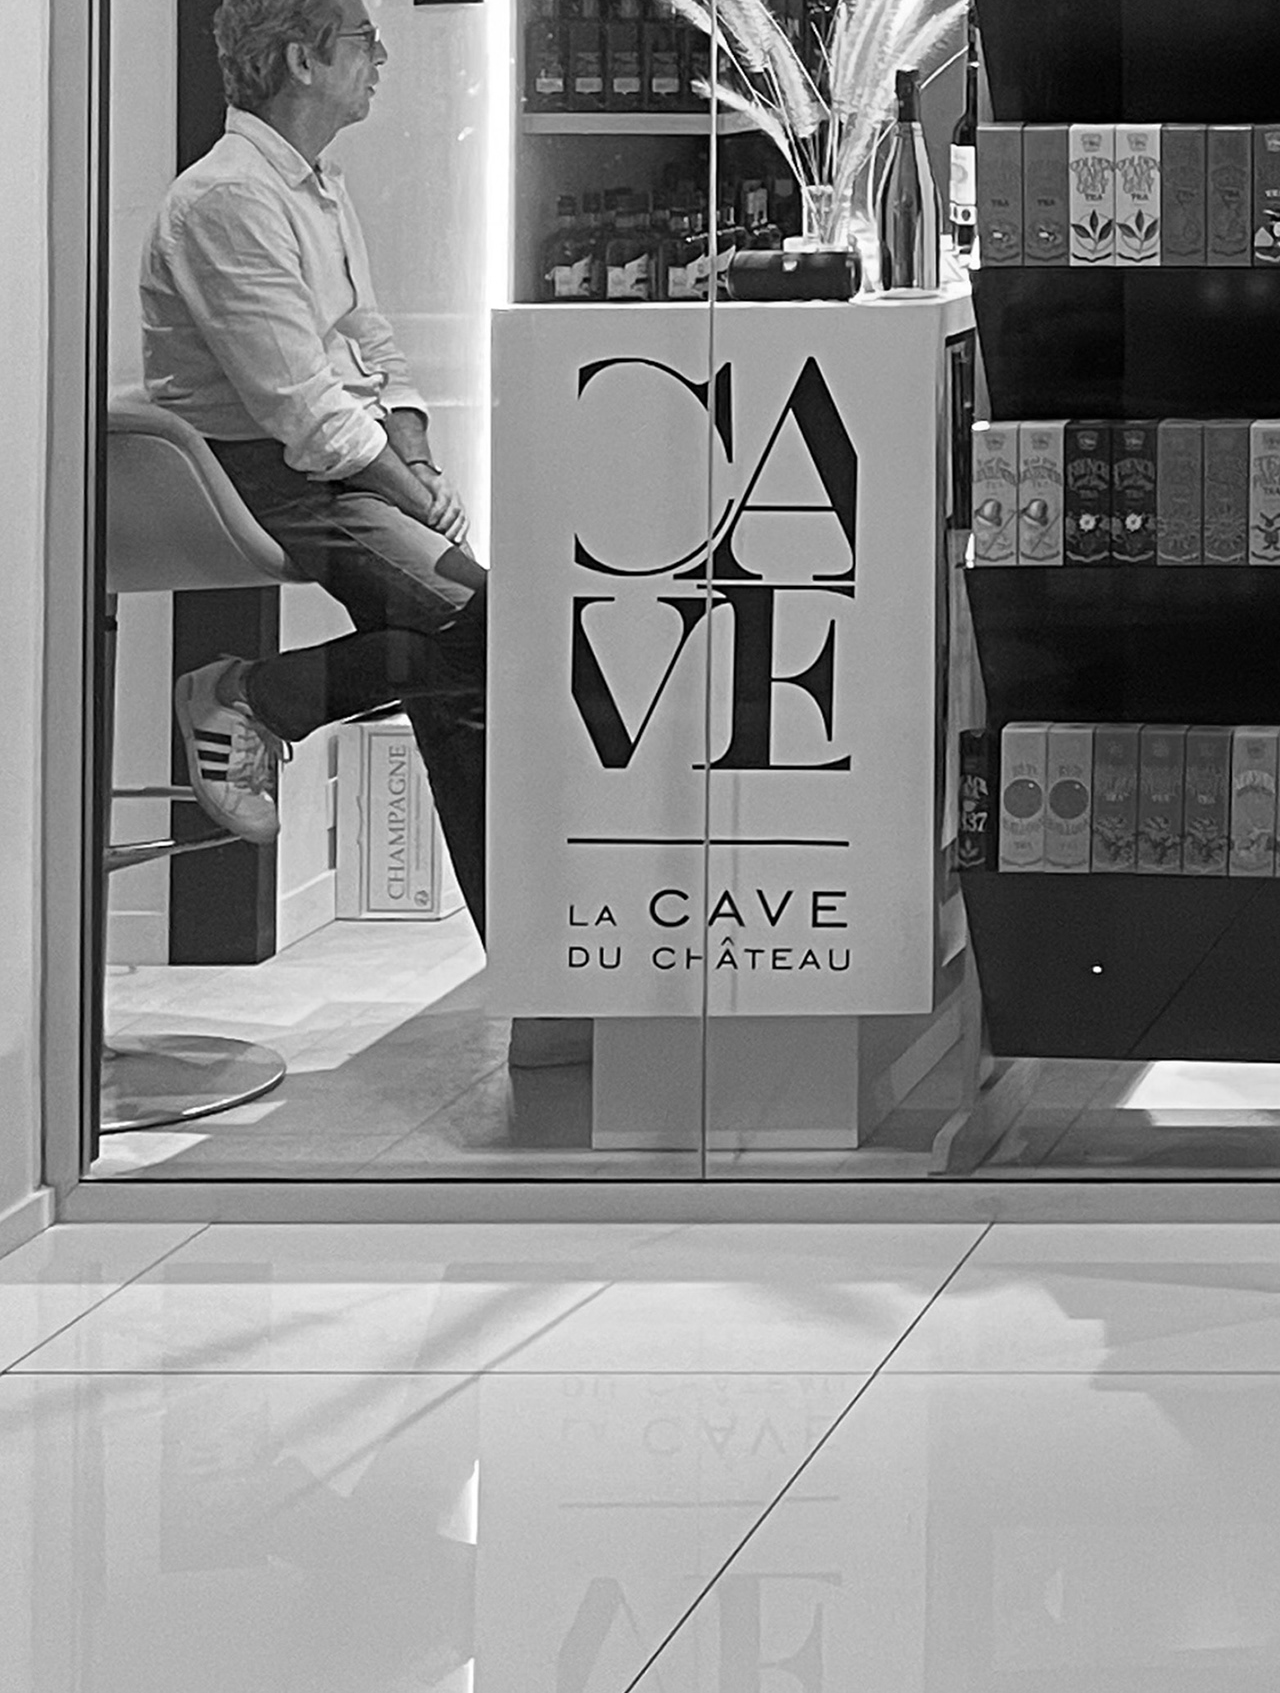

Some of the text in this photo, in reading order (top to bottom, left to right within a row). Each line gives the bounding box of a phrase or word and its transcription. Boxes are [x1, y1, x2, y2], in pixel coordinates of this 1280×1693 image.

[387, 744, 407, 900] CHAMPAGNE
[569, 889, 849, 928] LA CAVE
[568, 938, 851, 972] DU CHÂTEAU
